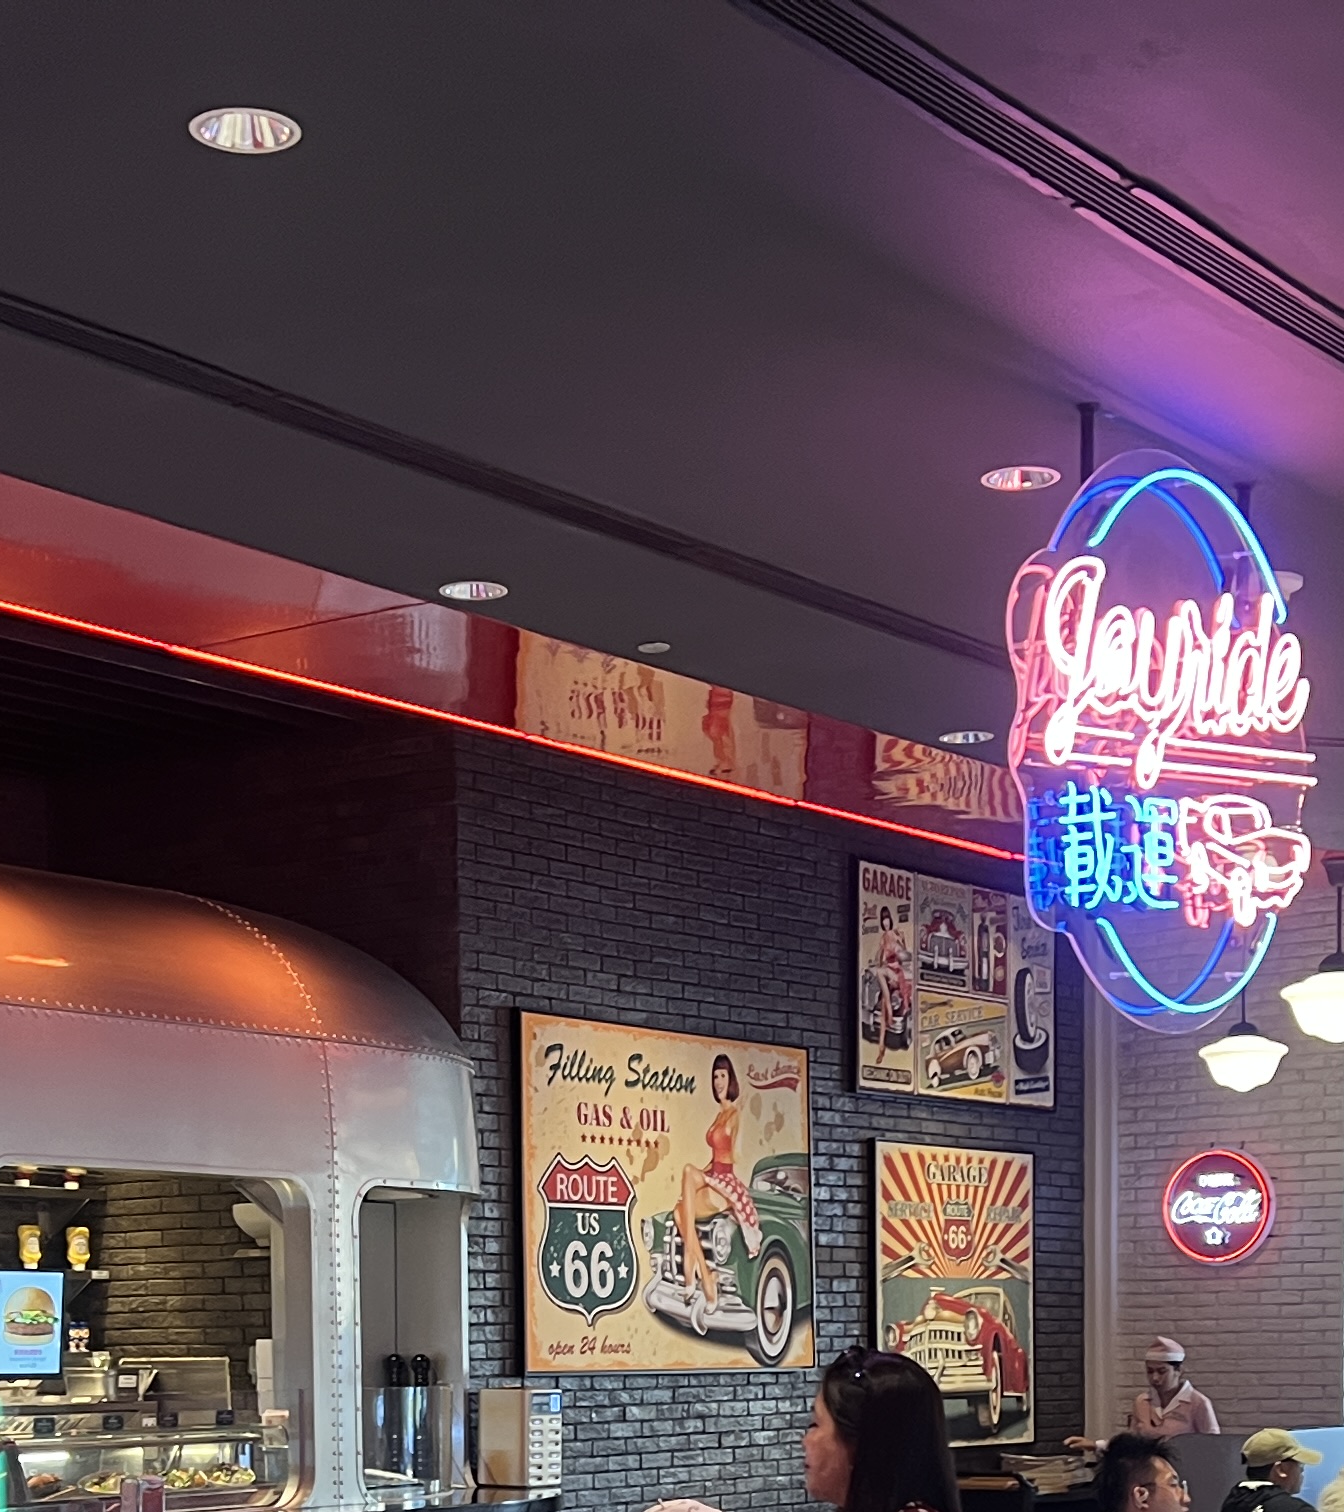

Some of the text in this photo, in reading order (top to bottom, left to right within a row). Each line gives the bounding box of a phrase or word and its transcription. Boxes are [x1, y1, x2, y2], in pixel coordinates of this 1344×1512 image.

[862, 867, 912, 901] GARAGE
[544, 1043, 697, 1096] Filling Station
[576, 1101, 671, 1133] GAS & OIL
[926, 1162, 989, 1185] GARAGE
[555, 1172, 618, 1203] ROUTE
[946, 1203, 969, 1217] ROUTE
[575, 1212, 600, 1236] US
[948, 1225, 967, 1249] 66
[564, 1239, 615, 1299] 66
[548, 1335, 632, 1357] open 24 hours
